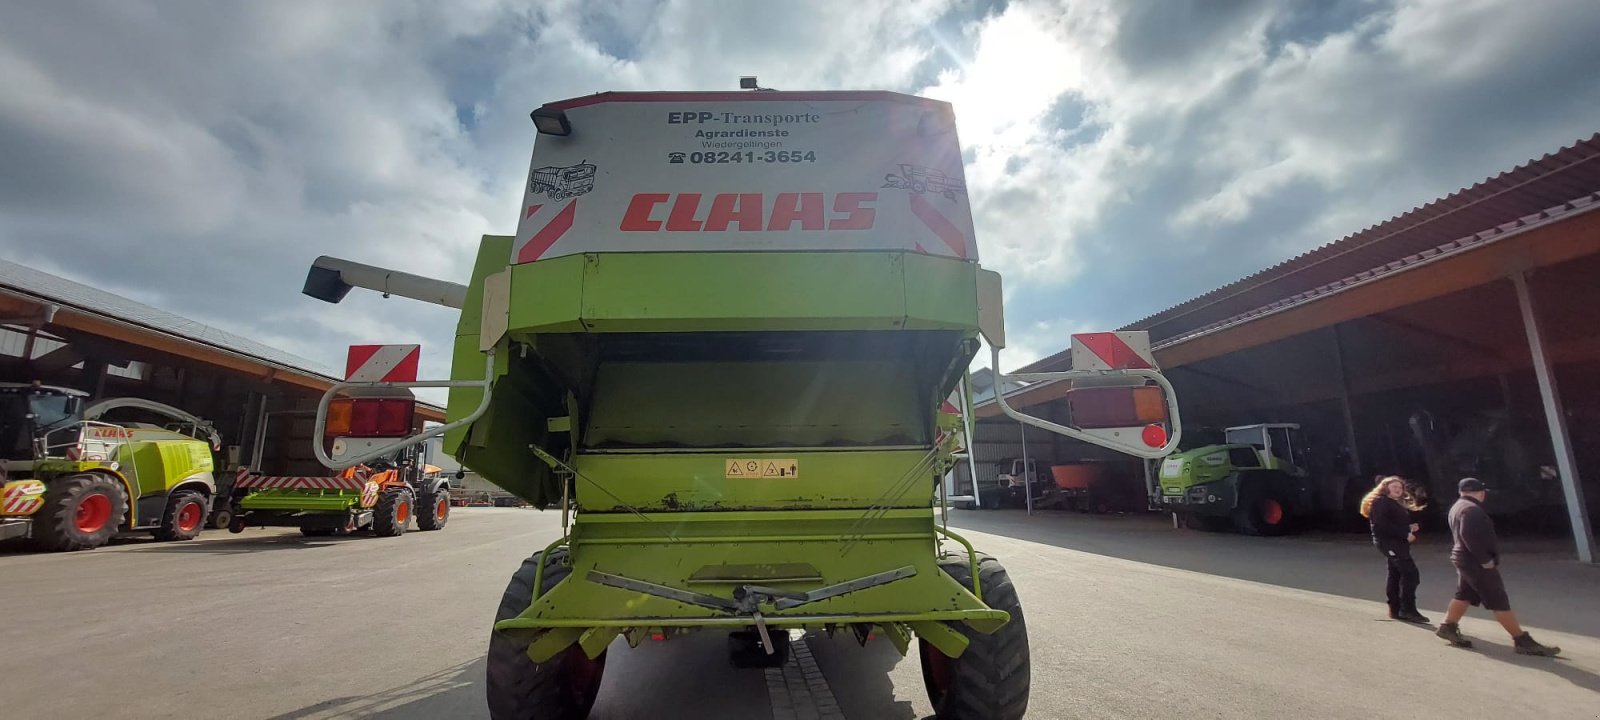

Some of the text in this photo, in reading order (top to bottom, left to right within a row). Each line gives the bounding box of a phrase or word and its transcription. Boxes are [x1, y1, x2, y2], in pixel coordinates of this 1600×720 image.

[668, 111, 820, 126] EPP-Transporte
[695, 129, 790, 139] Agrardienste
[702, 140, 783, 149] Wiedergeltingen
[690, 150, 816, 164] 08241-3654
[619, 192, 878, 231] CLAAS
